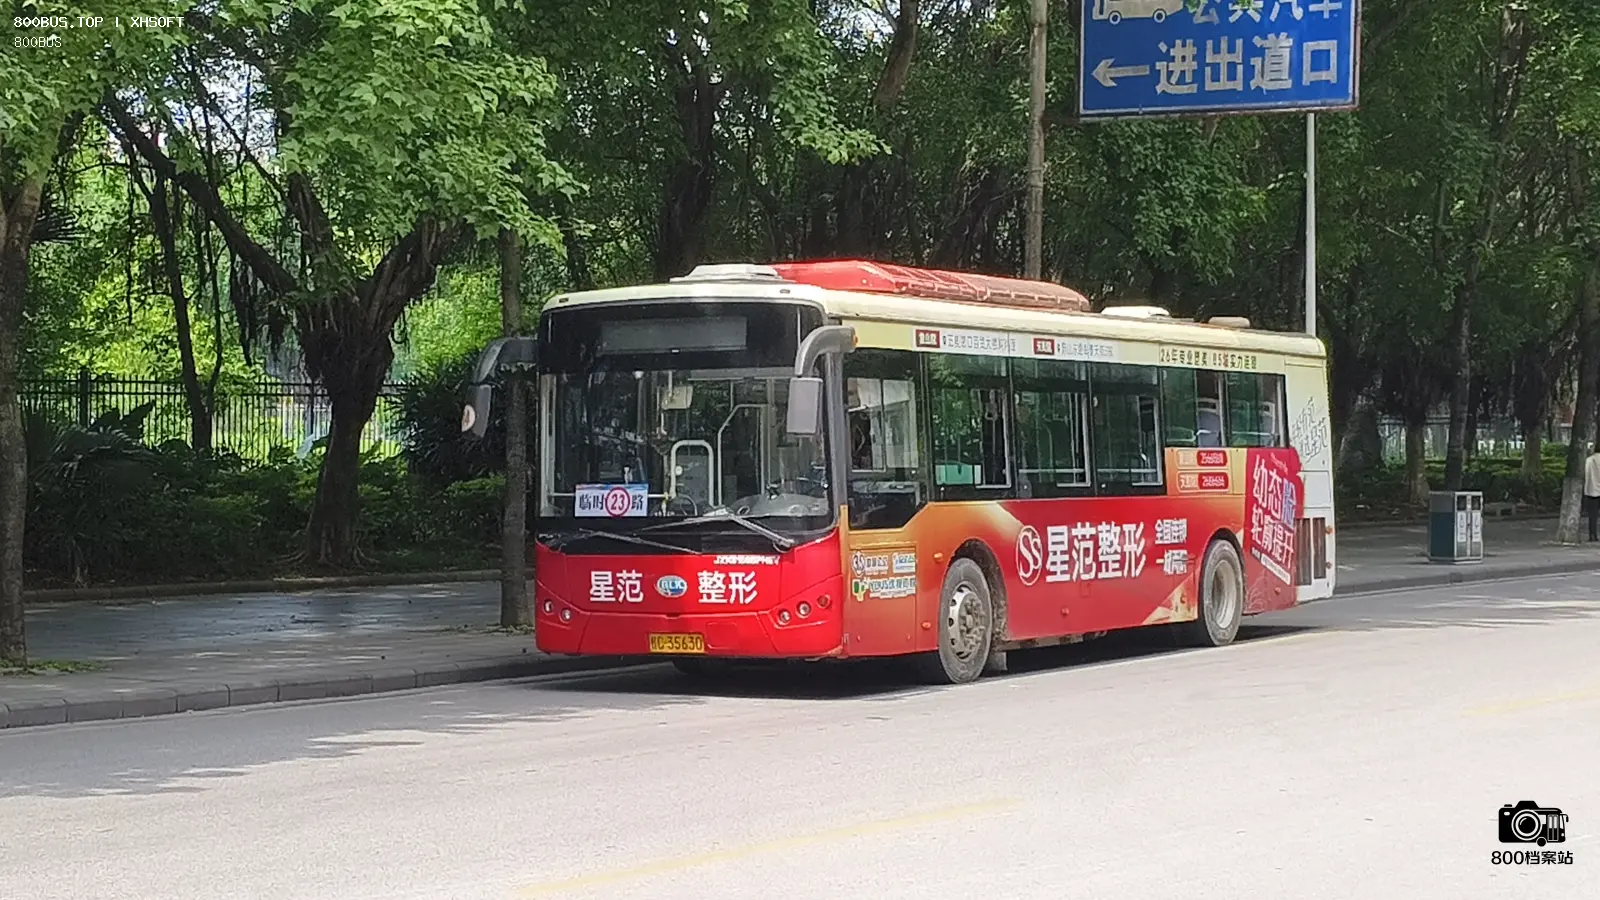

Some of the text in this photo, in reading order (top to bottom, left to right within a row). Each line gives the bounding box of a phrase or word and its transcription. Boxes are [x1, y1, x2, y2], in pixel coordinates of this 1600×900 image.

[1155, 32, 1338, 95] 进出道口
[1252, 454, 1296, 530] 幼态脸
[1046, 521, 1146, 582] 星范整形
[1251, 504, 1295, 569] 轮廓提升
[590, 569, 758, 604] 星范 整形
